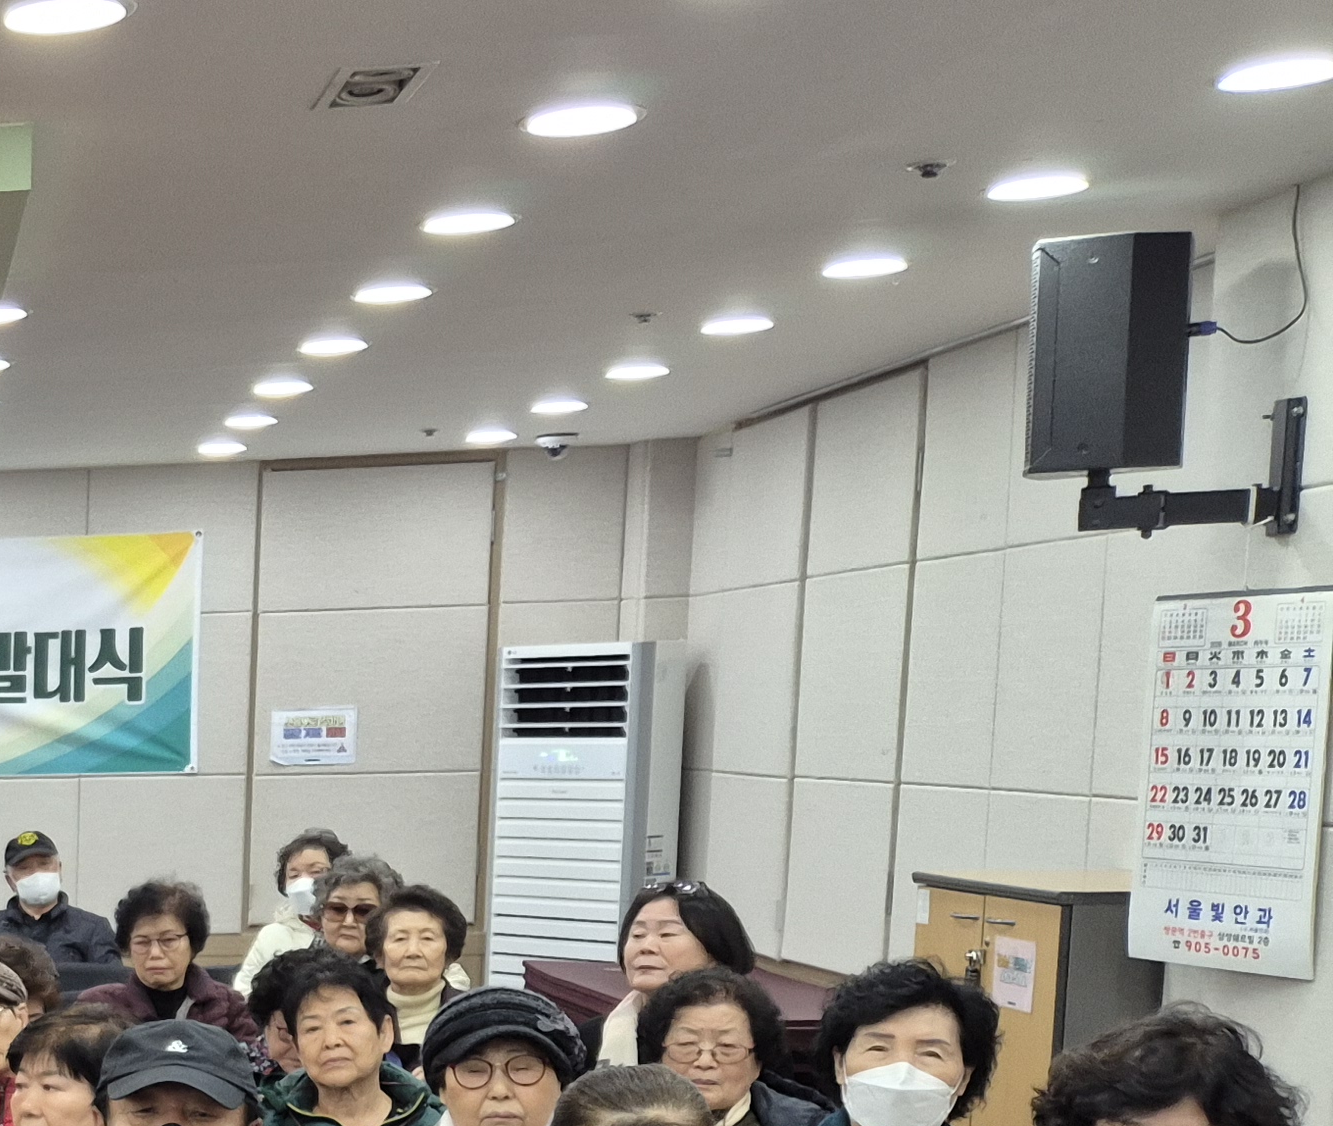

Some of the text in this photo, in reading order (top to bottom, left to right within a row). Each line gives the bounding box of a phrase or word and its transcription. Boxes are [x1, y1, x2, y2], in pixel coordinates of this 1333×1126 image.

[1230, 599, 1252, 638] 3
[1208, 650, 1222, 661] 火
[1279, 648, 1292, 660] 金
[1302, 647, 1316, 659] 土
[1164, 667, 1313, 689] 1 2 3 4 5 6 7
[1159, 708, 1312, 728] 8 9 10 11 12 13 14
[1154, 747, 1309, 769] 15 16 17 18 19 20 21
[1149, 785, 1168, 803] 22
[1171, 786, 1189, 804] 23
[1194, 786, 1212, 805] 24
[1217, 787, 1235, 806] 25
[1240, 788, 1259, 807] 26
[1264, 789, 1283, 809] 27
[1287, 790, 1307, 810] 28
[1146, 823, 1208, 844] 29 30 31
[1185, 940, 1261, 960] 905-0075
